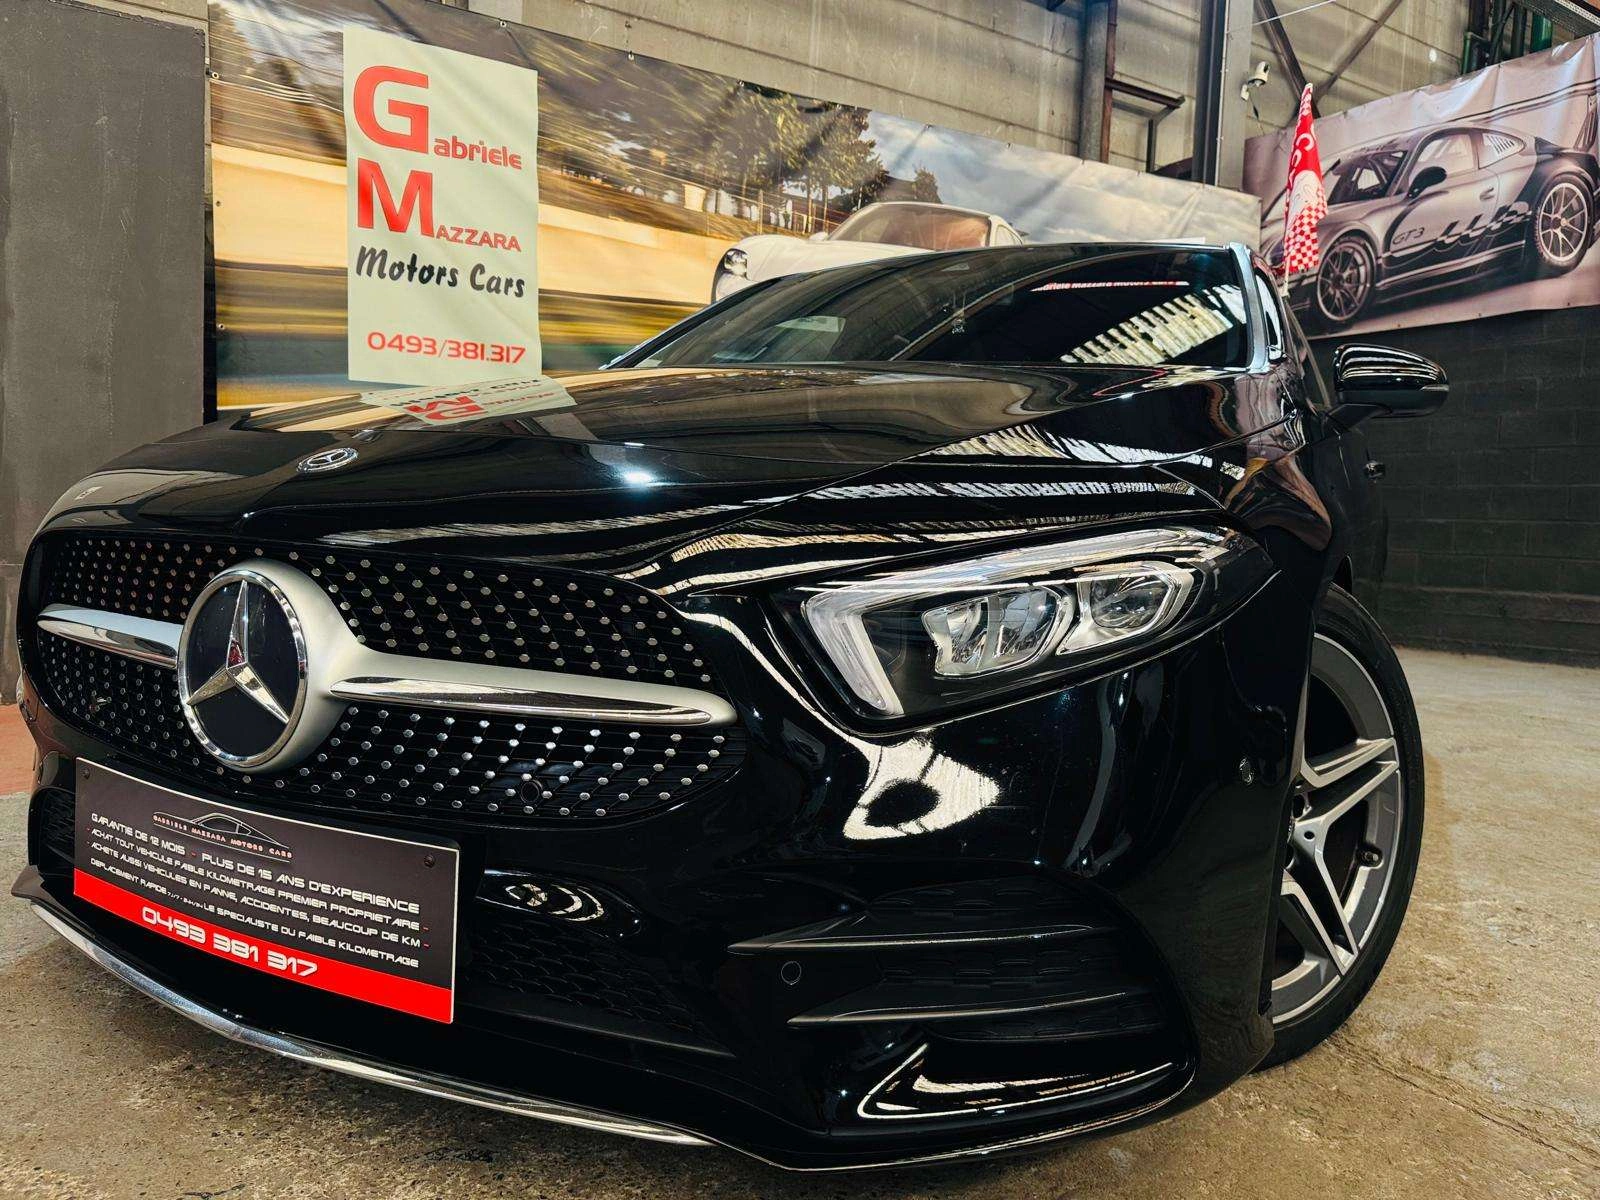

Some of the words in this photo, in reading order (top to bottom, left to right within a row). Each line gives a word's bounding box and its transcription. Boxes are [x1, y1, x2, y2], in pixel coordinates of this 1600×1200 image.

[353, 65, 522, 170] Gabriele
[357, 157, 522, 252] MAZZARA
[355, 245, 459, 288] Motors
[469, 262, 525, 298] Cars
[366, 331, 526, 364] 0493/381.317
[91, 812, 133, 837] GARANTIE
[134, 829, 148, 843] DE
[149, 835, 160, 847] 12
[161, 839, 186, 855] MOIS
[201, 852, 234, 870] PLUS
[236, 862, 255, 876] DE
[258, 868, 272, 881] 15
[276, 873, 305, 888] ANS
[308, 880, 420, 914] D'EXPERIENCE
[91, 828, 114, 842] ACHAT
[115, 837, 135, 851] TOUT
[136, 845, 174, 866] VEHICULE
[206, 869, 275, 897] KILOMETRAGE
[278, 889, 328, 910] PREMIER
[230, 838, 264, 852] MOTORS
[268, 847, 293, 859] CARS
[91, 841, 119, 858] ACHETE
[120, 853, 143, 867] AUSSI
[143, 862, 188, 885] VEHICULES
[189, 878, 202, 890] EN
[312, 914, 378, 936] BEAUCOUP
[381, 930, 399, 943] DE
[401, 935, 421, 948] KM
[142, 906, 206, 944] 0493
[213, 932, 260, 964] 381
[267, 951, 318, 978] 317
[203, 902, 215, 913] LE
[216, 907, 279, 932] SPECIALISTE
[280, 925, 296, 937] DU
[298, 930, 336, 947] FAIBLE
[338, 940, 420, 968] KILOMETRAGE
